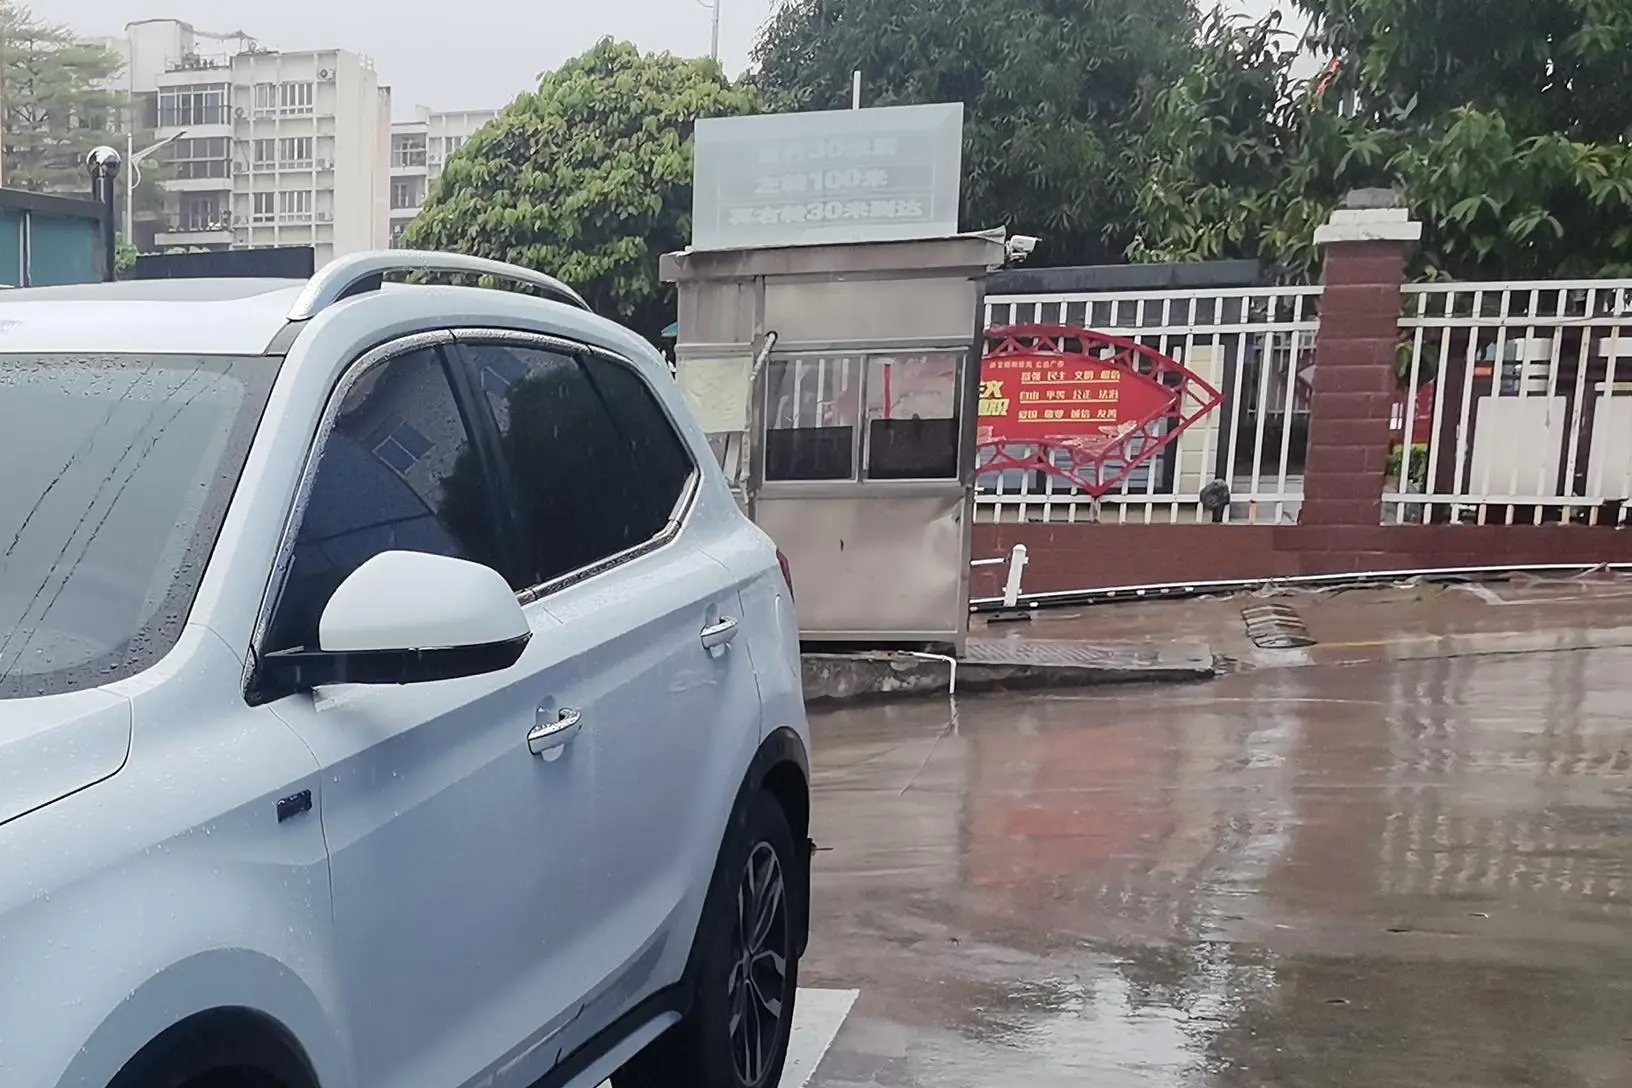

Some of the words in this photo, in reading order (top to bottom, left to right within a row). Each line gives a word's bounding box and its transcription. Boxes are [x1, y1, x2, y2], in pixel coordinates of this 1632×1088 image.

[1047, 371, 1066, 381] 民主
[1074, 370, 1094, 381] 文明
[1019, 390, 1040, 400] 自由
[1046, 390, 1066, 400] 平等
[1072, 389, 1091, 400] 公正
